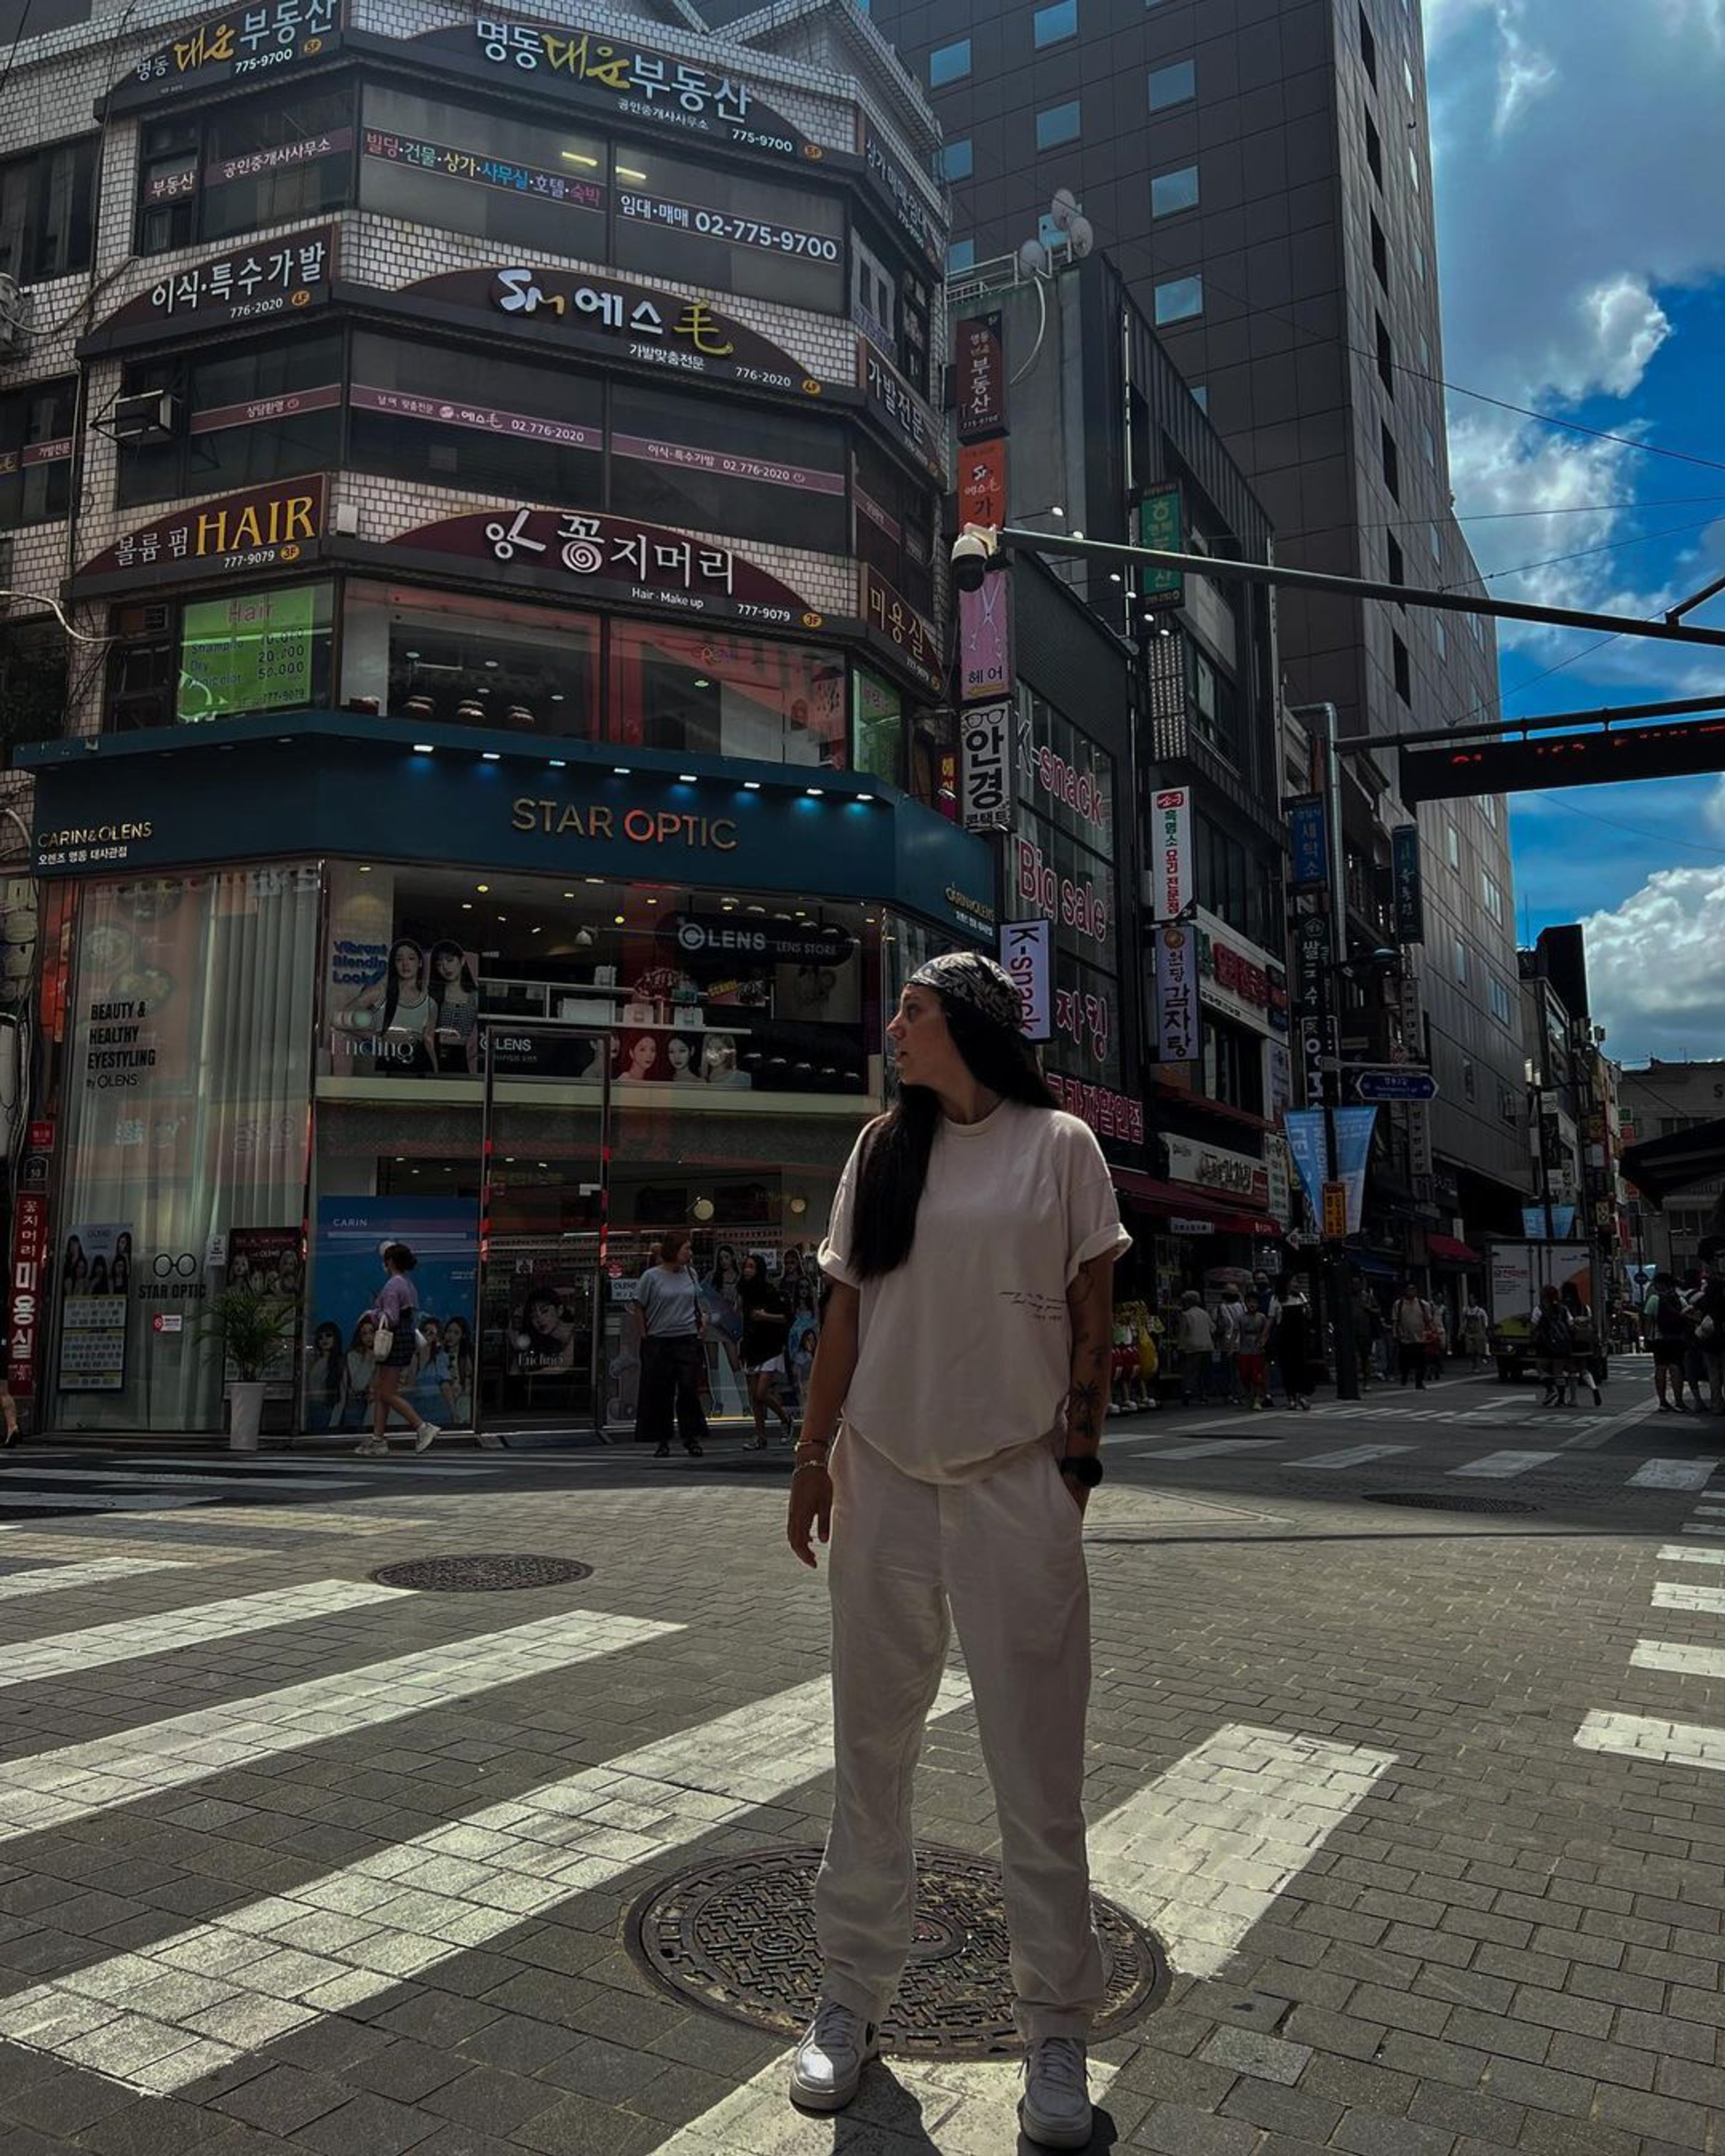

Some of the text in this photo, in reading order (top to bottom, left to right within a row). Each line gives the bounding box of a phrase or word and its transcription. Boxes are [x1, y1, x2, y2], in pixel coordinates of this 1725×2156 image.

[136, 55, 169, 80] 명동
[239, 0, 337, 50] 부동산
[234, 49, 293, 74] 775-9700
[477, 19, 544, 70] 명동
[629, 54, 753, 124] 부동산
[618, 98, 710, 131] 공인중개사사무소
[732, 128, 793, 153] 775-9700
[223, 138, 332, 178] 공인중개사사무소
[151, 172, 194, 196] 부동산
[695, 212, 837, 261] 02-775-9700
[230, 298, 283, 318] 776-2020
[629, 343, 705, 371] 가발맞춤전문
[735, 366, 792, 388] 776-2020
[971, 358, 991, 414] 부동산
[869, 358, 924, 445] 가발전문
[115, 495, 316, 567] 볼륨 펌 HAIR
[224, 548, 275, 569] 777-9079
[280, 544, 301, 561] 3F
[632, 588, 704, 610] Hair Make up
[738, 604, 791, 622] 777-9079
[870, 588, 924, 661] 미용실
[969, 666, 1003, 683] 헤어
[965, 726, 1005, 810] 안경
[511, 798, 739, 850] STAR OPTIC
[38, 852, 66, 866] 오렌즈
[68, 849, 87, 863] 명동
[1018, 838, 1059, 924] Big
[805, 944, 837, 956] STORE
[1009, 927, 1041, 1033] K-snack
[91, 1001, 146, 1021] BEAUTY &
[1163, 984, 1191, 1057] 감자탕
[89, 1025, 140, 1045] HEALTHY
[88, 1049, 155, 1069] EYESTYLING
[97, 1073, 138, 1089] OLENS
[333, 1218, 367, 1227] CARIN
[138, 1284, 206, 1299] STAR OPTIC
[12, 1261, 38, 1359] 미용실
